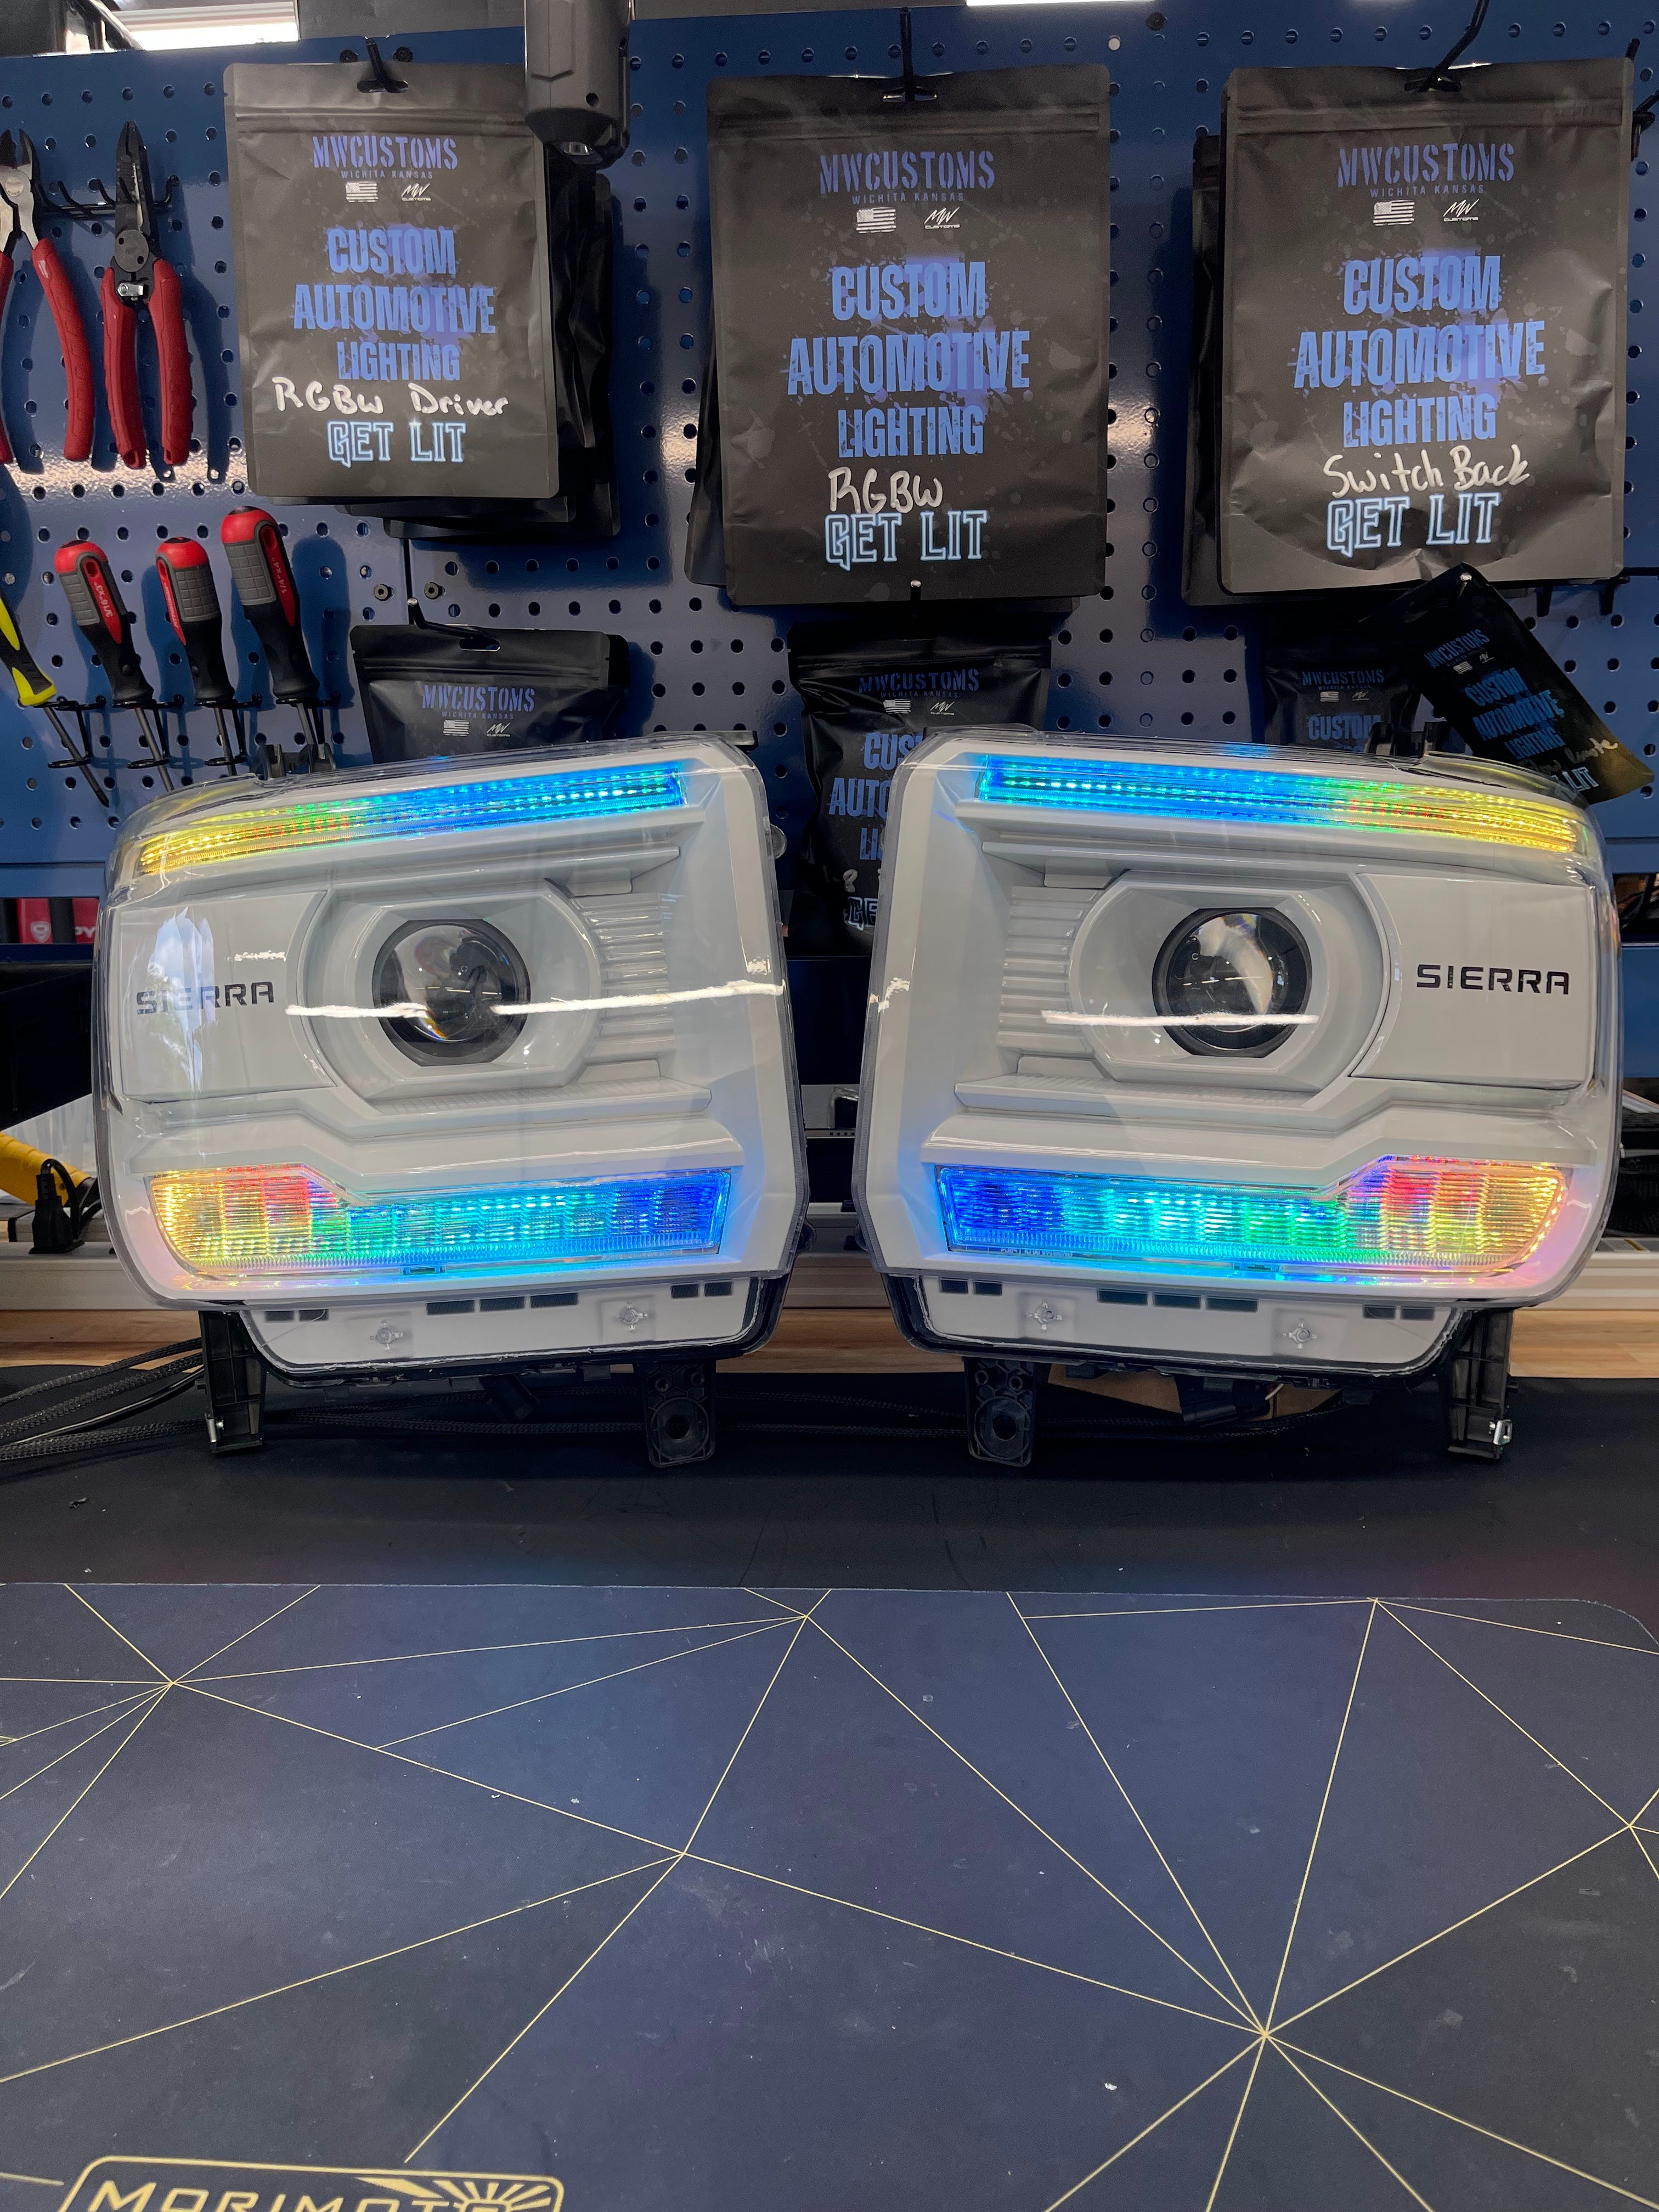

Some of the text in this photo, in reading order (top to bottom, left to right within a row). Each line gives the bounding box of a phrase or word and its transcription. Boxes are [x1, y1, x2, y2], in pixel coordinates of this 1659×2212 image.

[313, 136, 458, 170] MWCUSTOMS
[341, 170, 433, 179] WICHITA KANSAS
[820, 150, 995, 194] MWCUSTOMS
[1338, 144, 1515, 188] MWCUSTOMS
[852, 193, 964, 205] WICHITA KANSAS
[1370, 184, 1484, 198] WICHITA KANSAS
[329, 229, 456, 274] CUSTOM
[832, 262, 986, 320] CUSTOM
[1344, 255, 1501, 315] CUSTOM
[294, 284, 496, 334] AUTOMOTIVE
[337, 341, 461, 381] LIGHTING
[787, 331, 1031, 396] AUTOMOTIVE
[1294, 321, 1545, 388] AUTOMOTIVE
[408, 383, 509, 416] Driver
[1343, 393, 1497, 448] LIGHTING
[328, 419, 466, 468] GET LIT
[838, 405, 984, 458] LIGHTING
[1323, 444, 1531, 498] Switch Back
[825, 510, 987, 571] GET LIT
[1327, 492, 1500, 558] GET LIT
[1424, 629, 1490, 668] MWCUSTOMS
[422, 685, 535, 713] MWCUSTOMS
[859, 669, 979, 693] MWCUSTOMS
[1302, 669, 1385, 686] MWCUSTOMS
[1464, 667, 1529, 706] CUSTOM
[1472, 689, 1565, 741] AUTOMOTIVE
[1504, 726, 1566, 760] LIGHTING
[137, 981, 274, 1015] SIERRA
[1417, 964, 1569, 995] SIERRA
